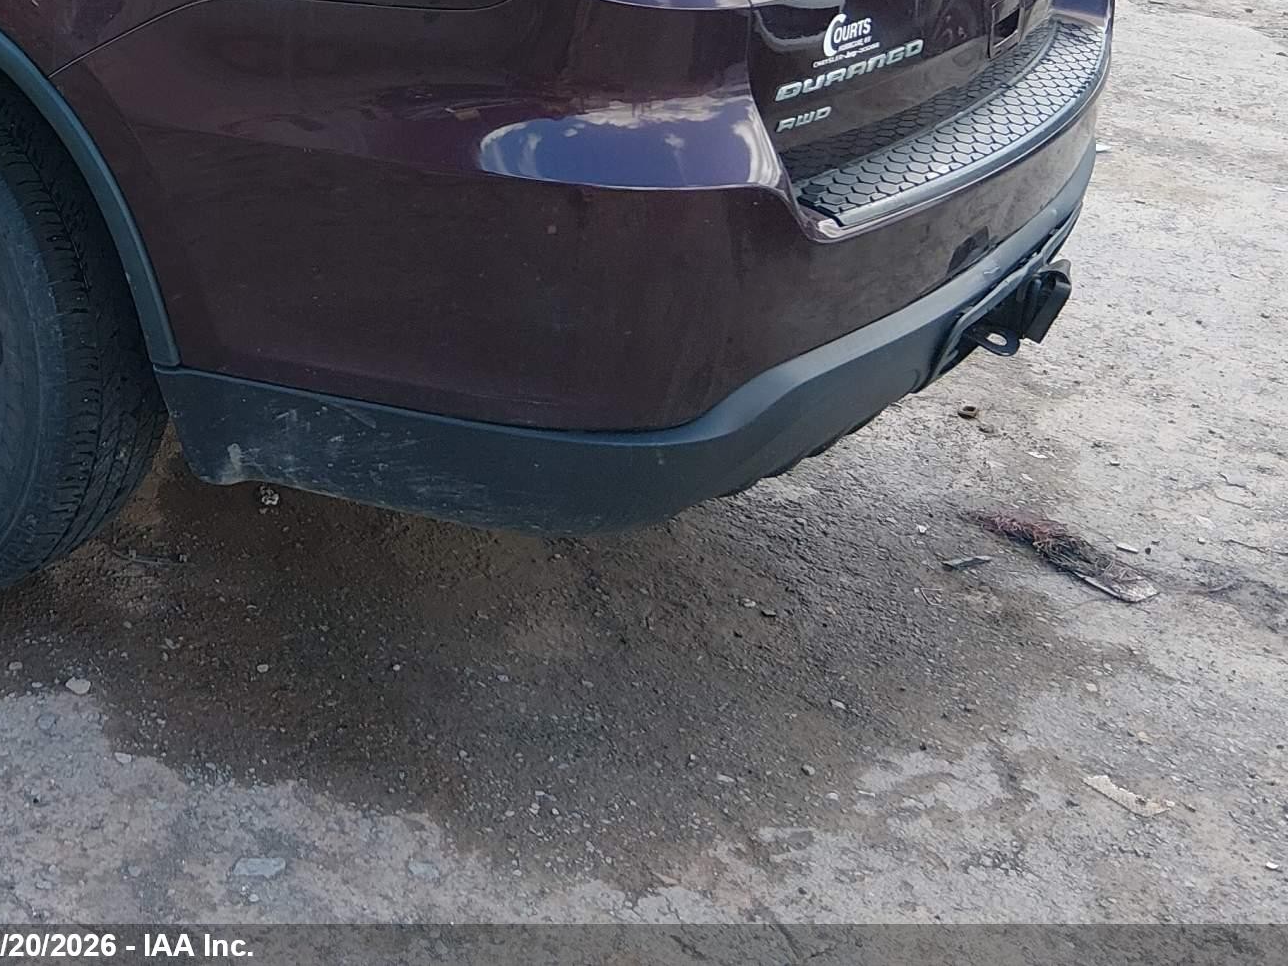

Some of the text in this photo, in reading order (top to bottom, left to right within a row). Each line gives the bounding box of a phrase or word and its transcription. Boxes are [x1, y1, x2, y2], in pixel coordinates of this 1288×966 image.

[823, 13, 872, 57] COURTS
[775, 39, 924, 102] DURANGO
[776, 106, 832, 133] AWD
